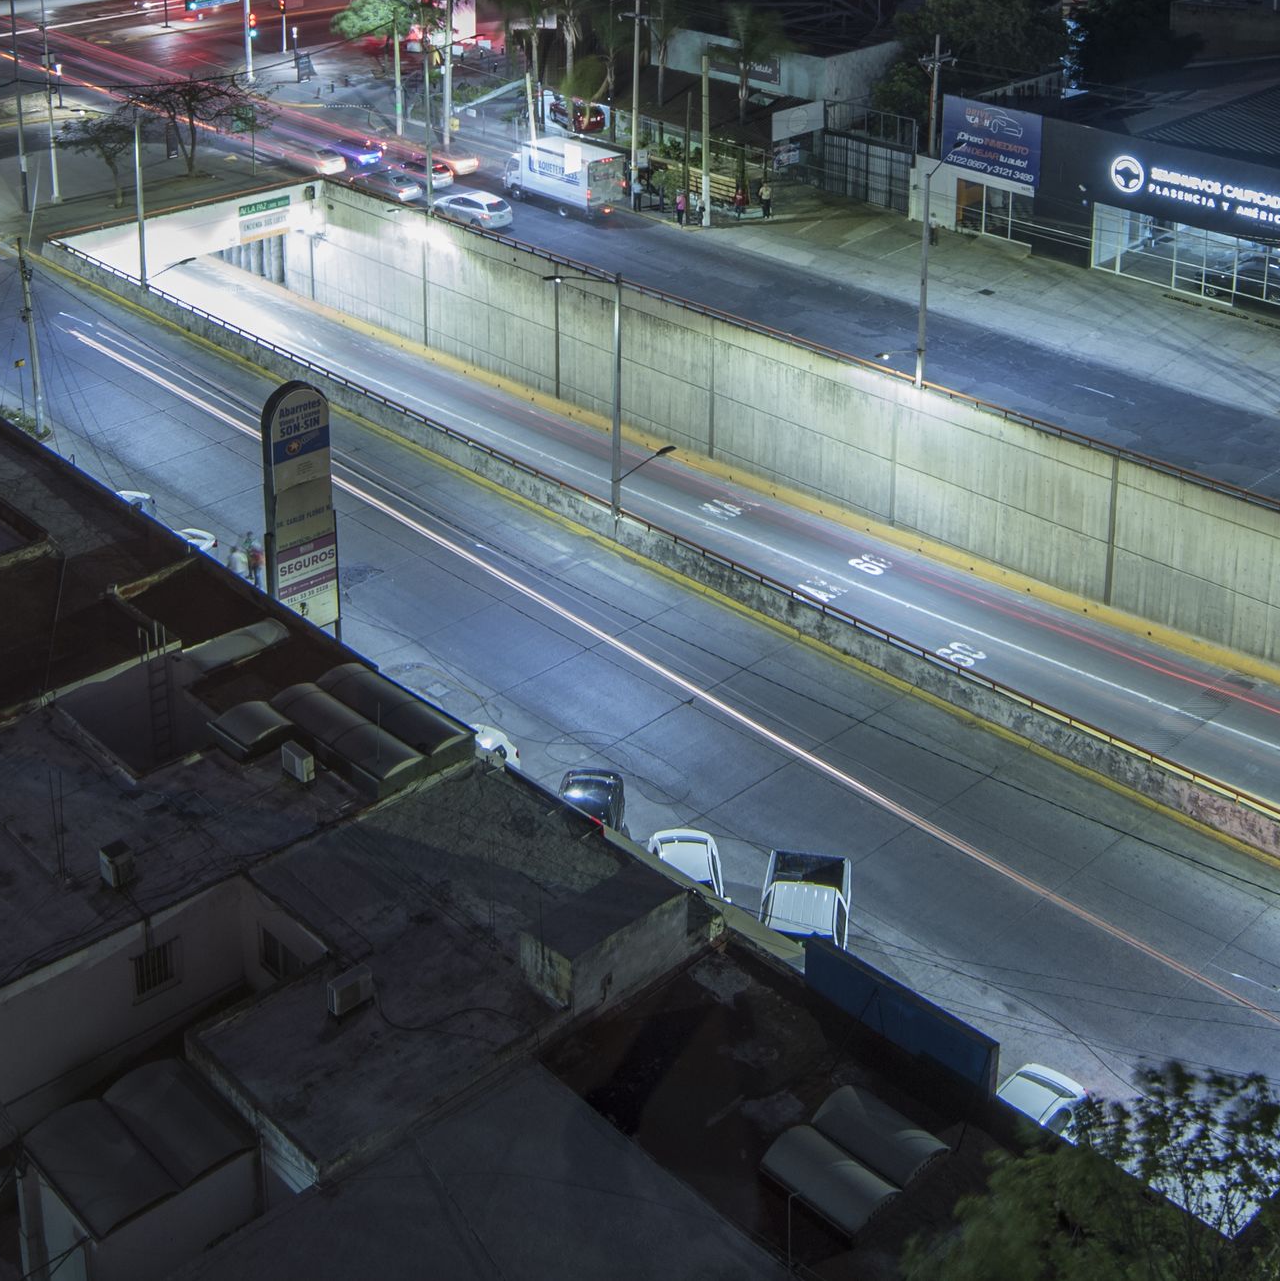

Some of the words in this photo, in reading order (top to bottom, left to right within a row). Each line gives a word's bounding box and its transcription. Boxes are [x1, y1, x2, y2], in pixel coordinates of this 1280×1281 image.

[1148, 183, 1215, 208] PLASENCIA
[1222, 201, 1229, 211] Y
[279, 398, 321, 418] Abarrotes
[280, 416, 320, 438] SON-SIN
[279, 548, 335, 577] SEGUROS
